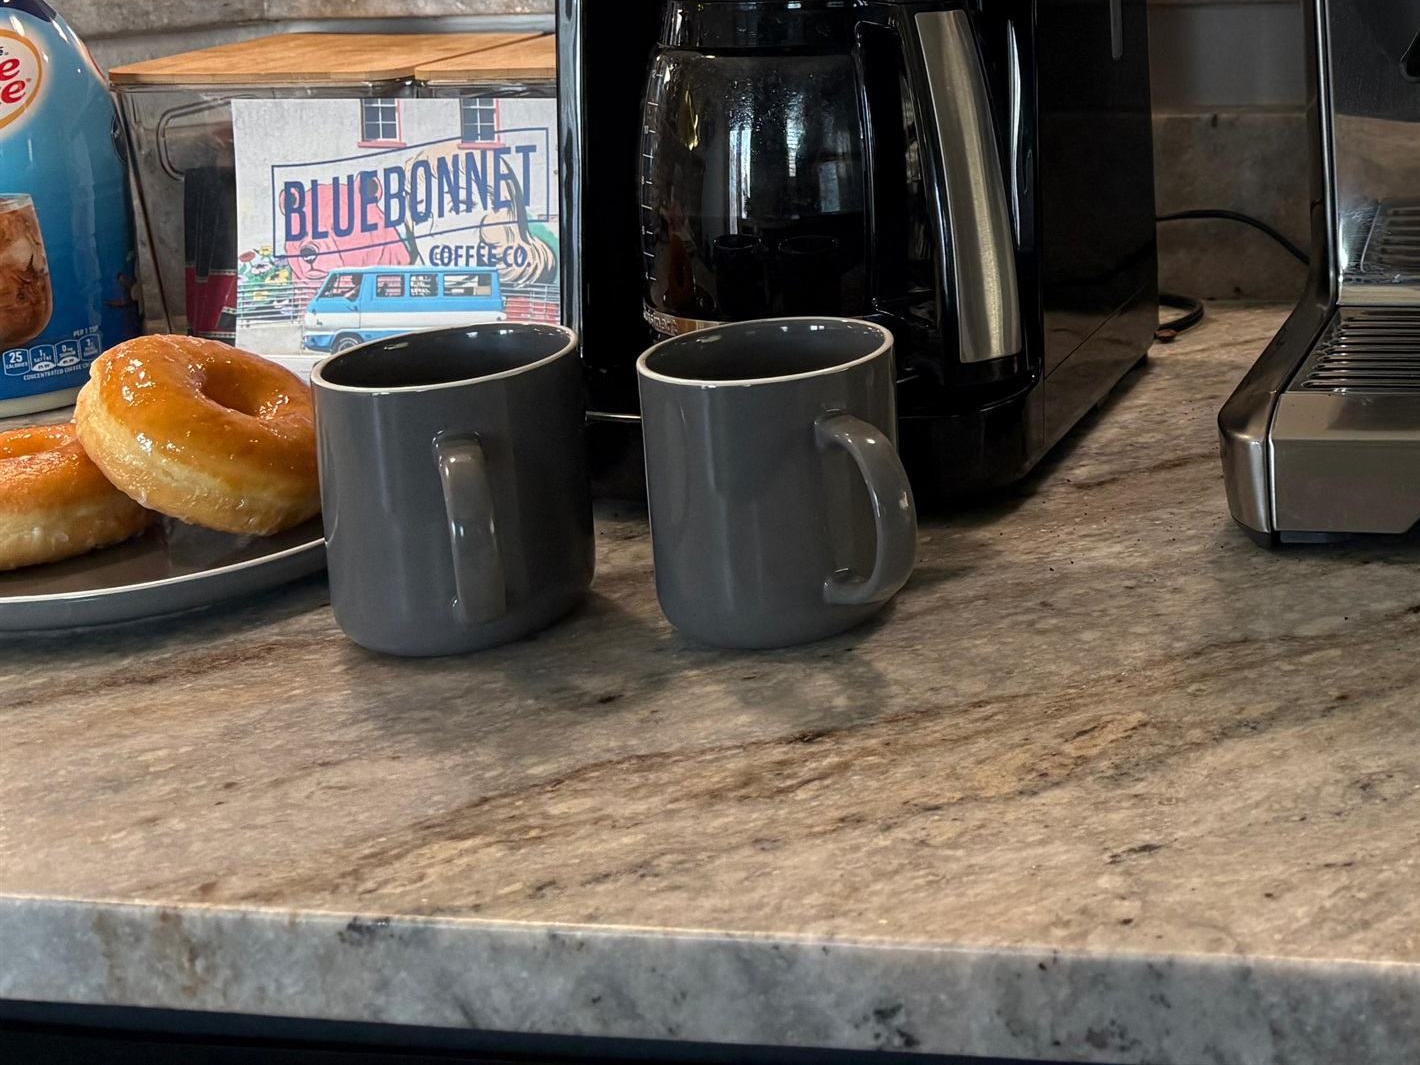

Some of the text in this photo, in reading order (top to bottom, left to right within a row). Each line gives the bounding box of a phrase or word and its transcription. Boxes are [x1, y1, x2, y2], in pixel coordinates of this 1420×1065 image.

[284, 144, 537, 242] BLUEBONNET
[429, 245, 532, 268] COFFEE CO.
[9, 351, 23, 363] 25
